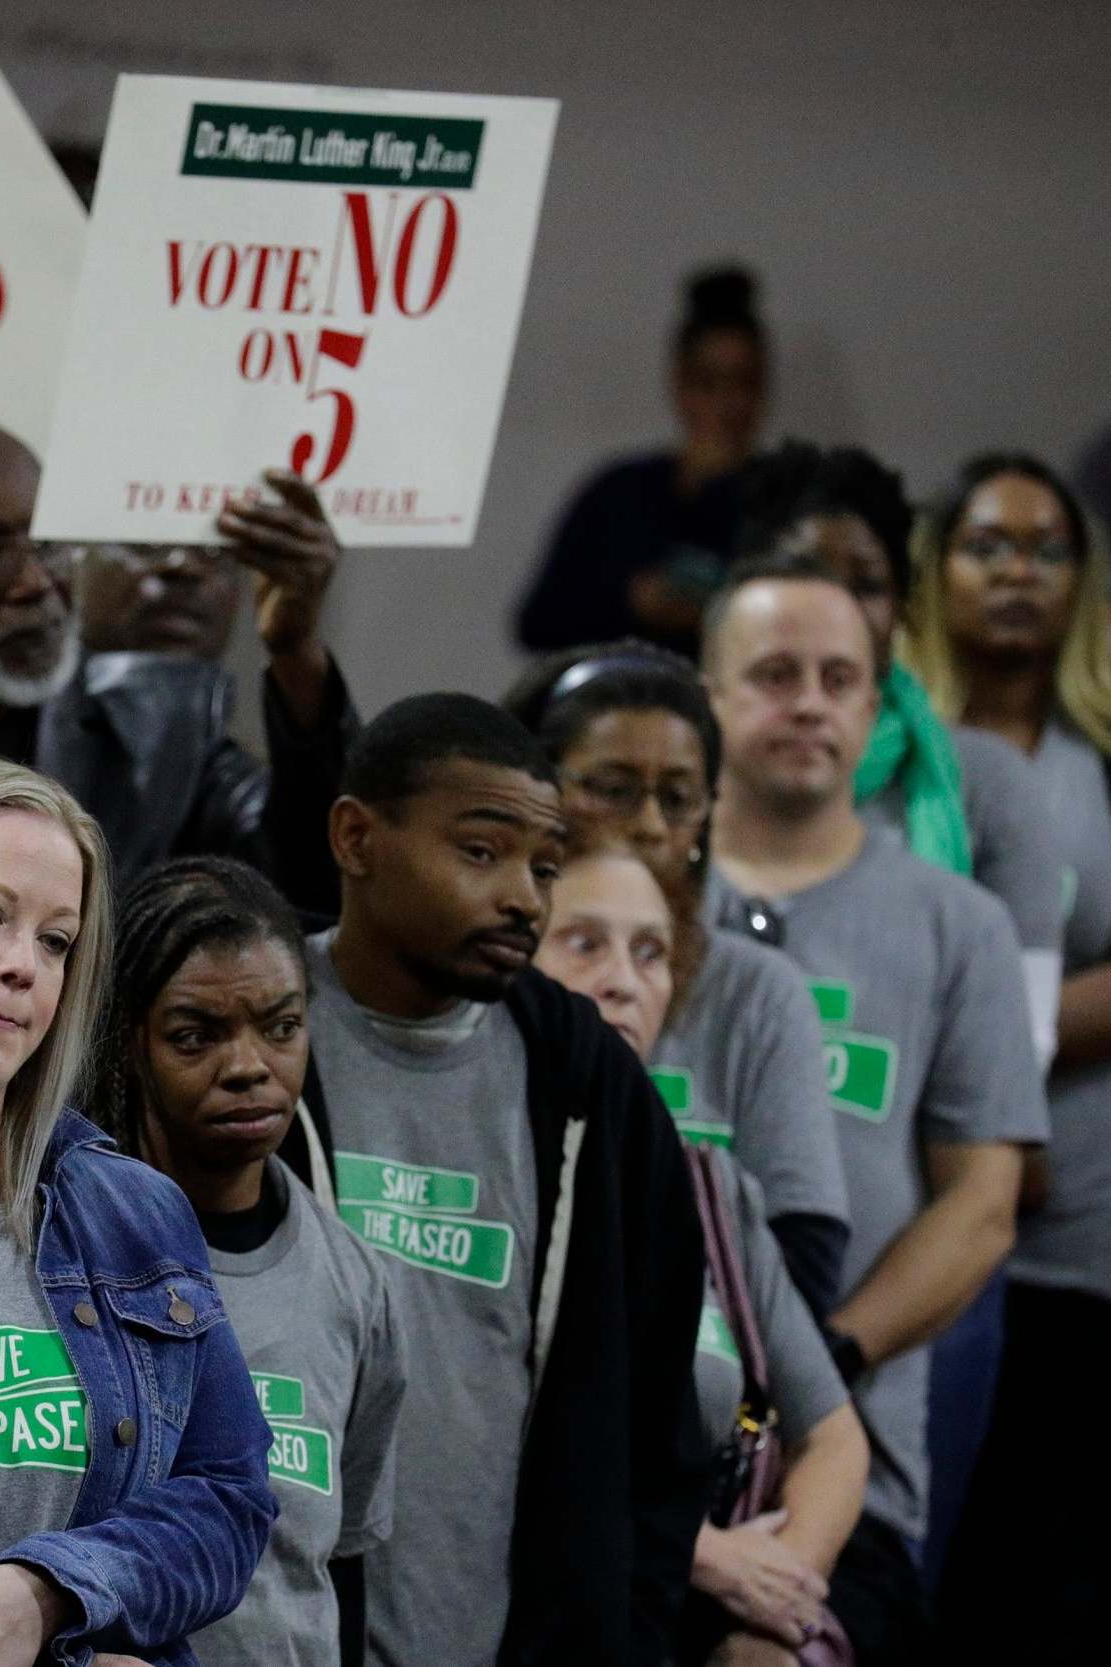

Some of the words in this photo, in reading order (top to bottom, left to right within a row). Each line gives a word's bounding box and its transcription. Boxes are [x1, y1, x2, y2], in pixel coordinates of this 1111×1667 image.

[299, 128, 369, 168] Luther
[370, 131, 417, 181] King
[167, 240, 321, 314] VOTE
[323, 192, 458, 317] NO
[239, 328, 309, 384] ON
[291, 328, 365, 484] 5
[126, 483, 165, 512] TO
[382, 1166, 431, 1205] SAVE
[362, 1208, 395, 1244] THE
[397, 1217, 473, 1266] PASEO
[268, 1431, 308, 1473] SEO
